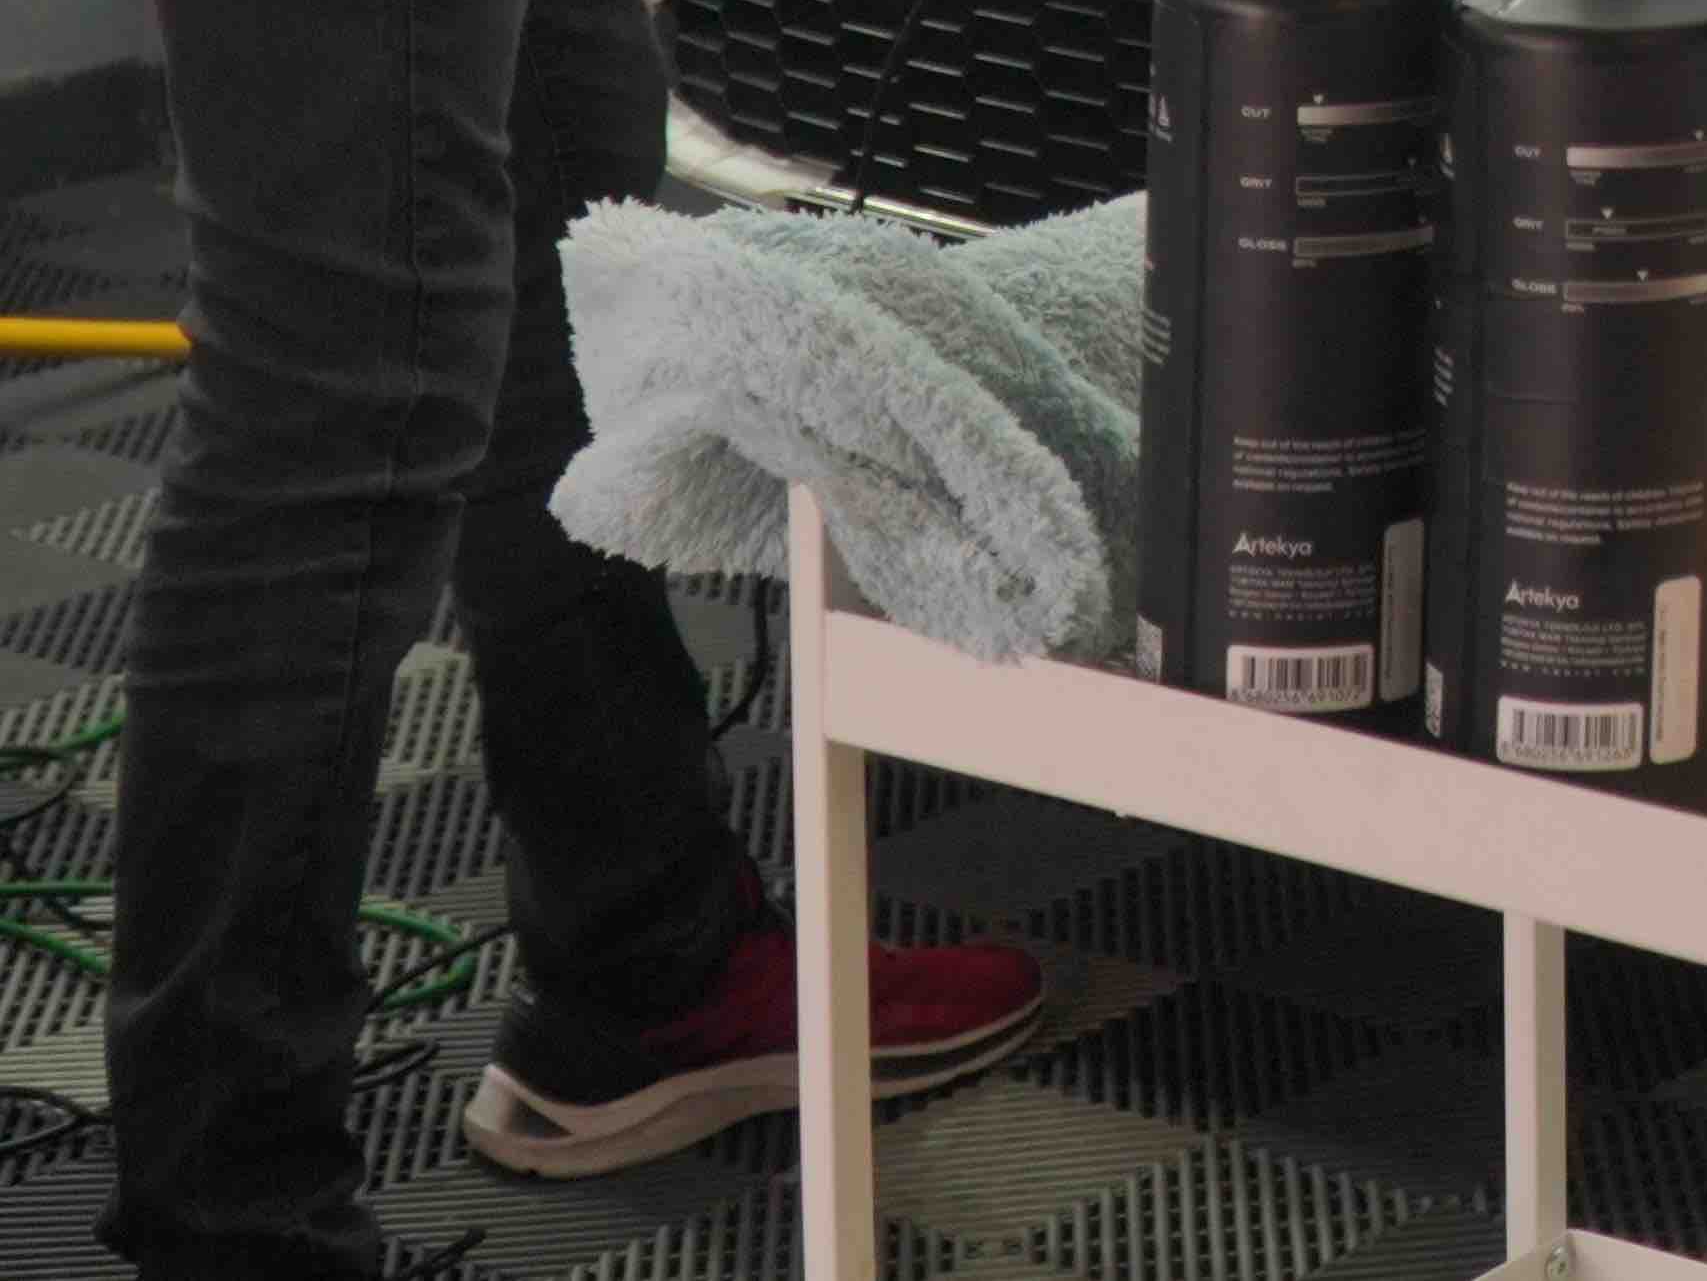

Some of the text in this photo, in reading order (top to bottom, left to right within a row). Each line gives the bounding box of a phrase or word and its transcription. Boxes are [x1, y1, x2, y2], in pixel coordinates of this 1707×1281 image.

[1240, 106, 1272, 119] CUT
[1513, 145, 1542, 158] CUT
[1238, 237, 1288, 252] GLOSS
[1231, 531, 1313, 560] Artekya
[1504, 578, 1580, 613] Artekya
